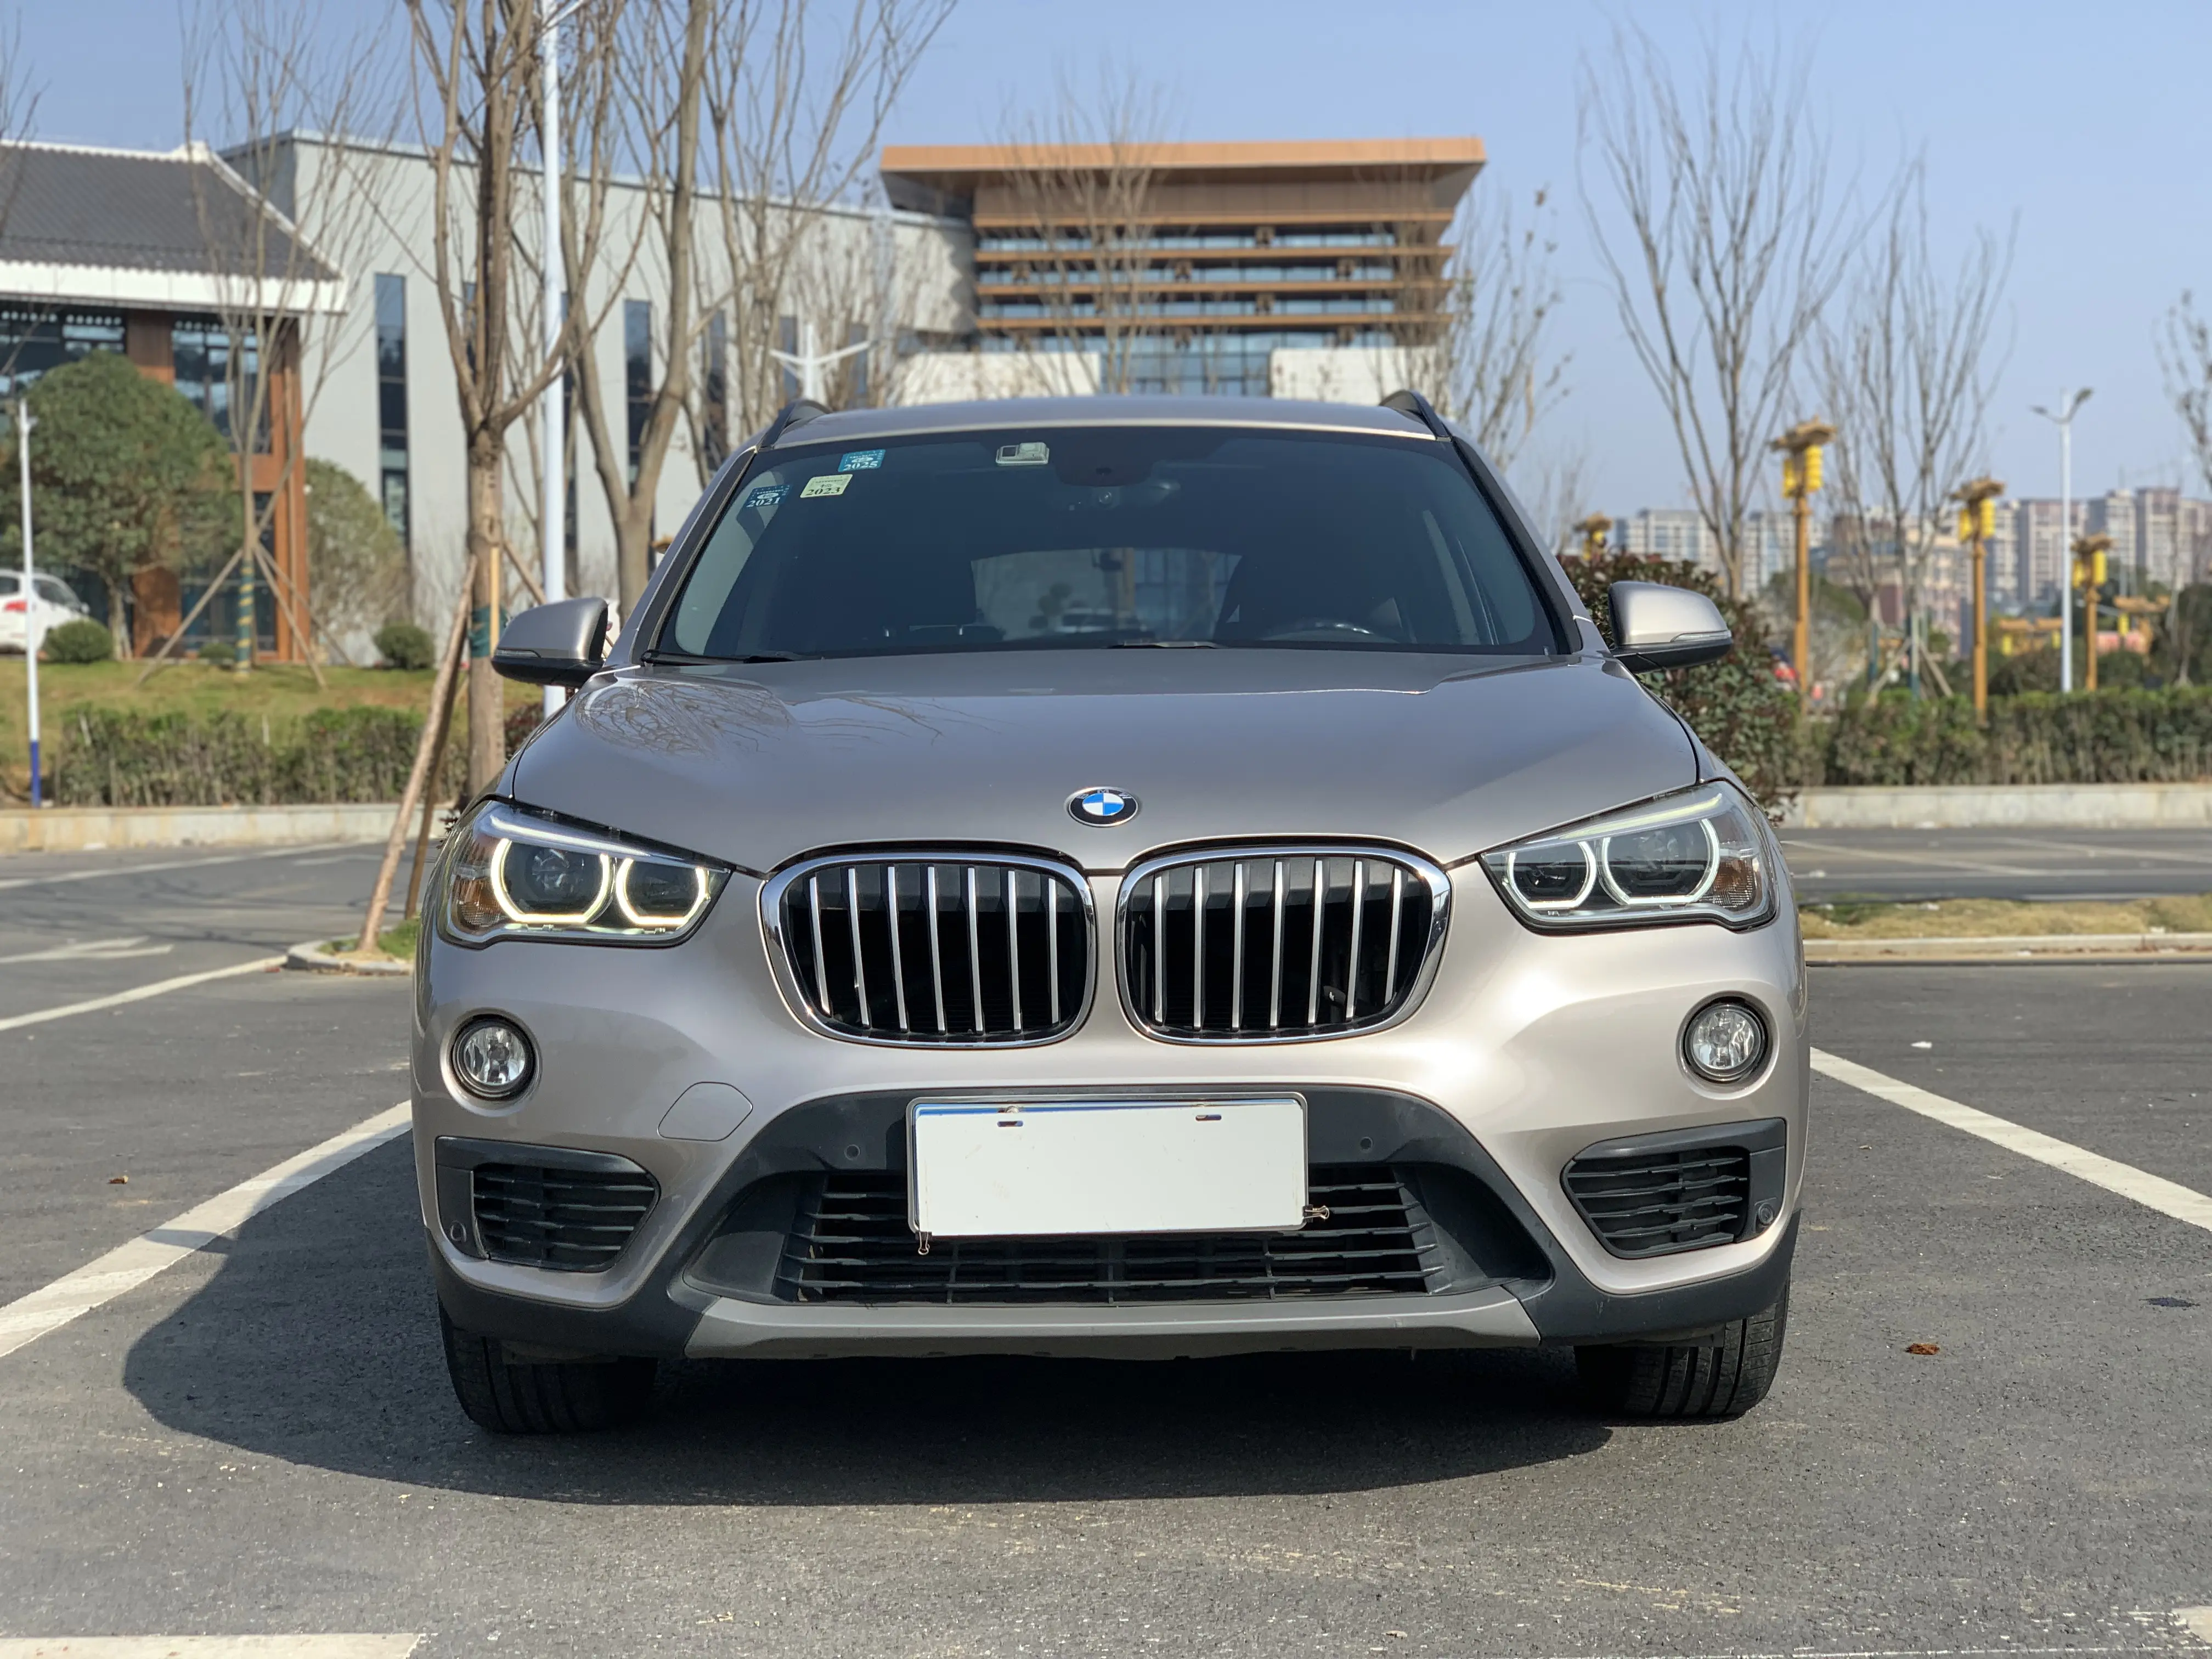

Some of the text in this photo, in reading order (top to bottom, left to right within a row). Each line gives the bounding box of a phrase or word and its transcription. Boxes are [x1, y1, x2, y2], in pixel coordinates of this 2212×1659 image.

[843, 461, 878, 471] 2025
[805, 487, 840, 496] 2023
[746, 496, 781, 507] 2021
[1076, 789, 1132, 799] BMW
